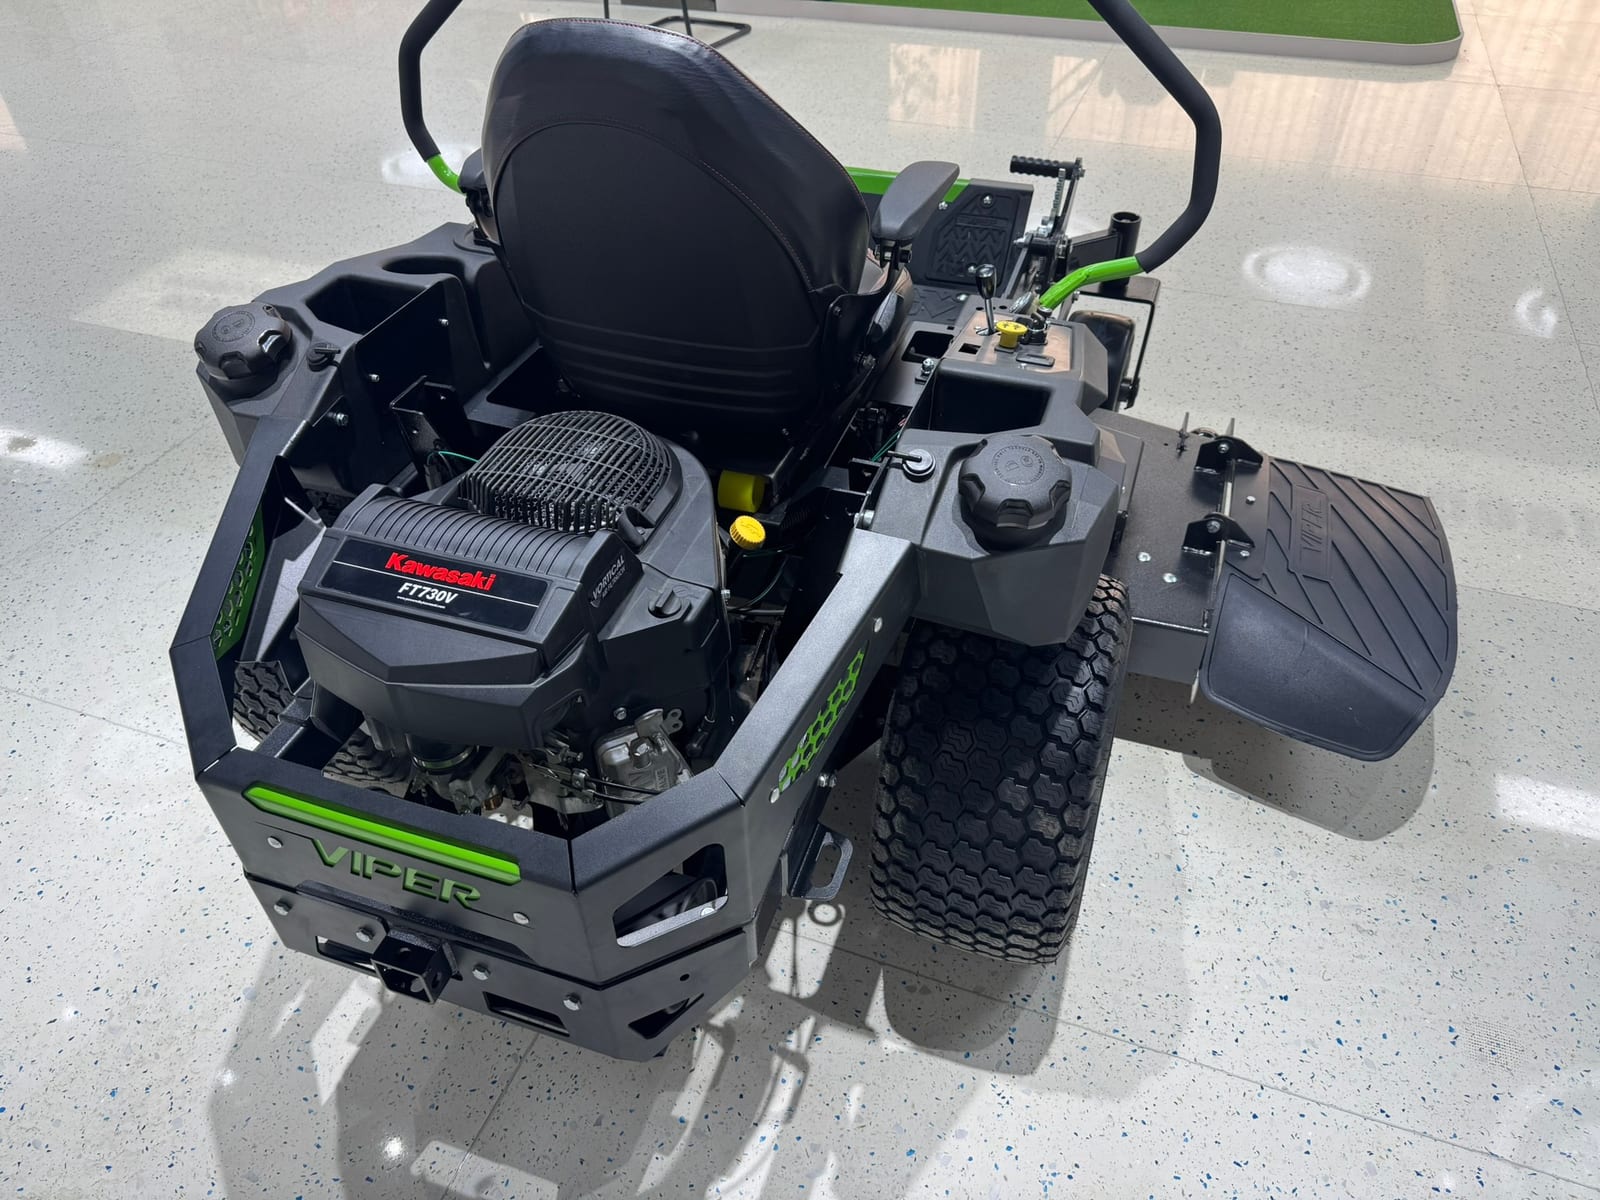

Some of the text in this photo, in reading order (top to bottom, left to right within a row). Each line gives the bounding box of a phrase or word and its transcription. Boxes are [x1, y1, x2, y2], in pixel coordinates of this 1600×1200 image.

[385, 552, 497, 591] Kawasaki
[592, 554, 625, 600] VORTICAL
[398, 582, 459, 604] FT730V
[311, 838, 481, 909] VIPER
